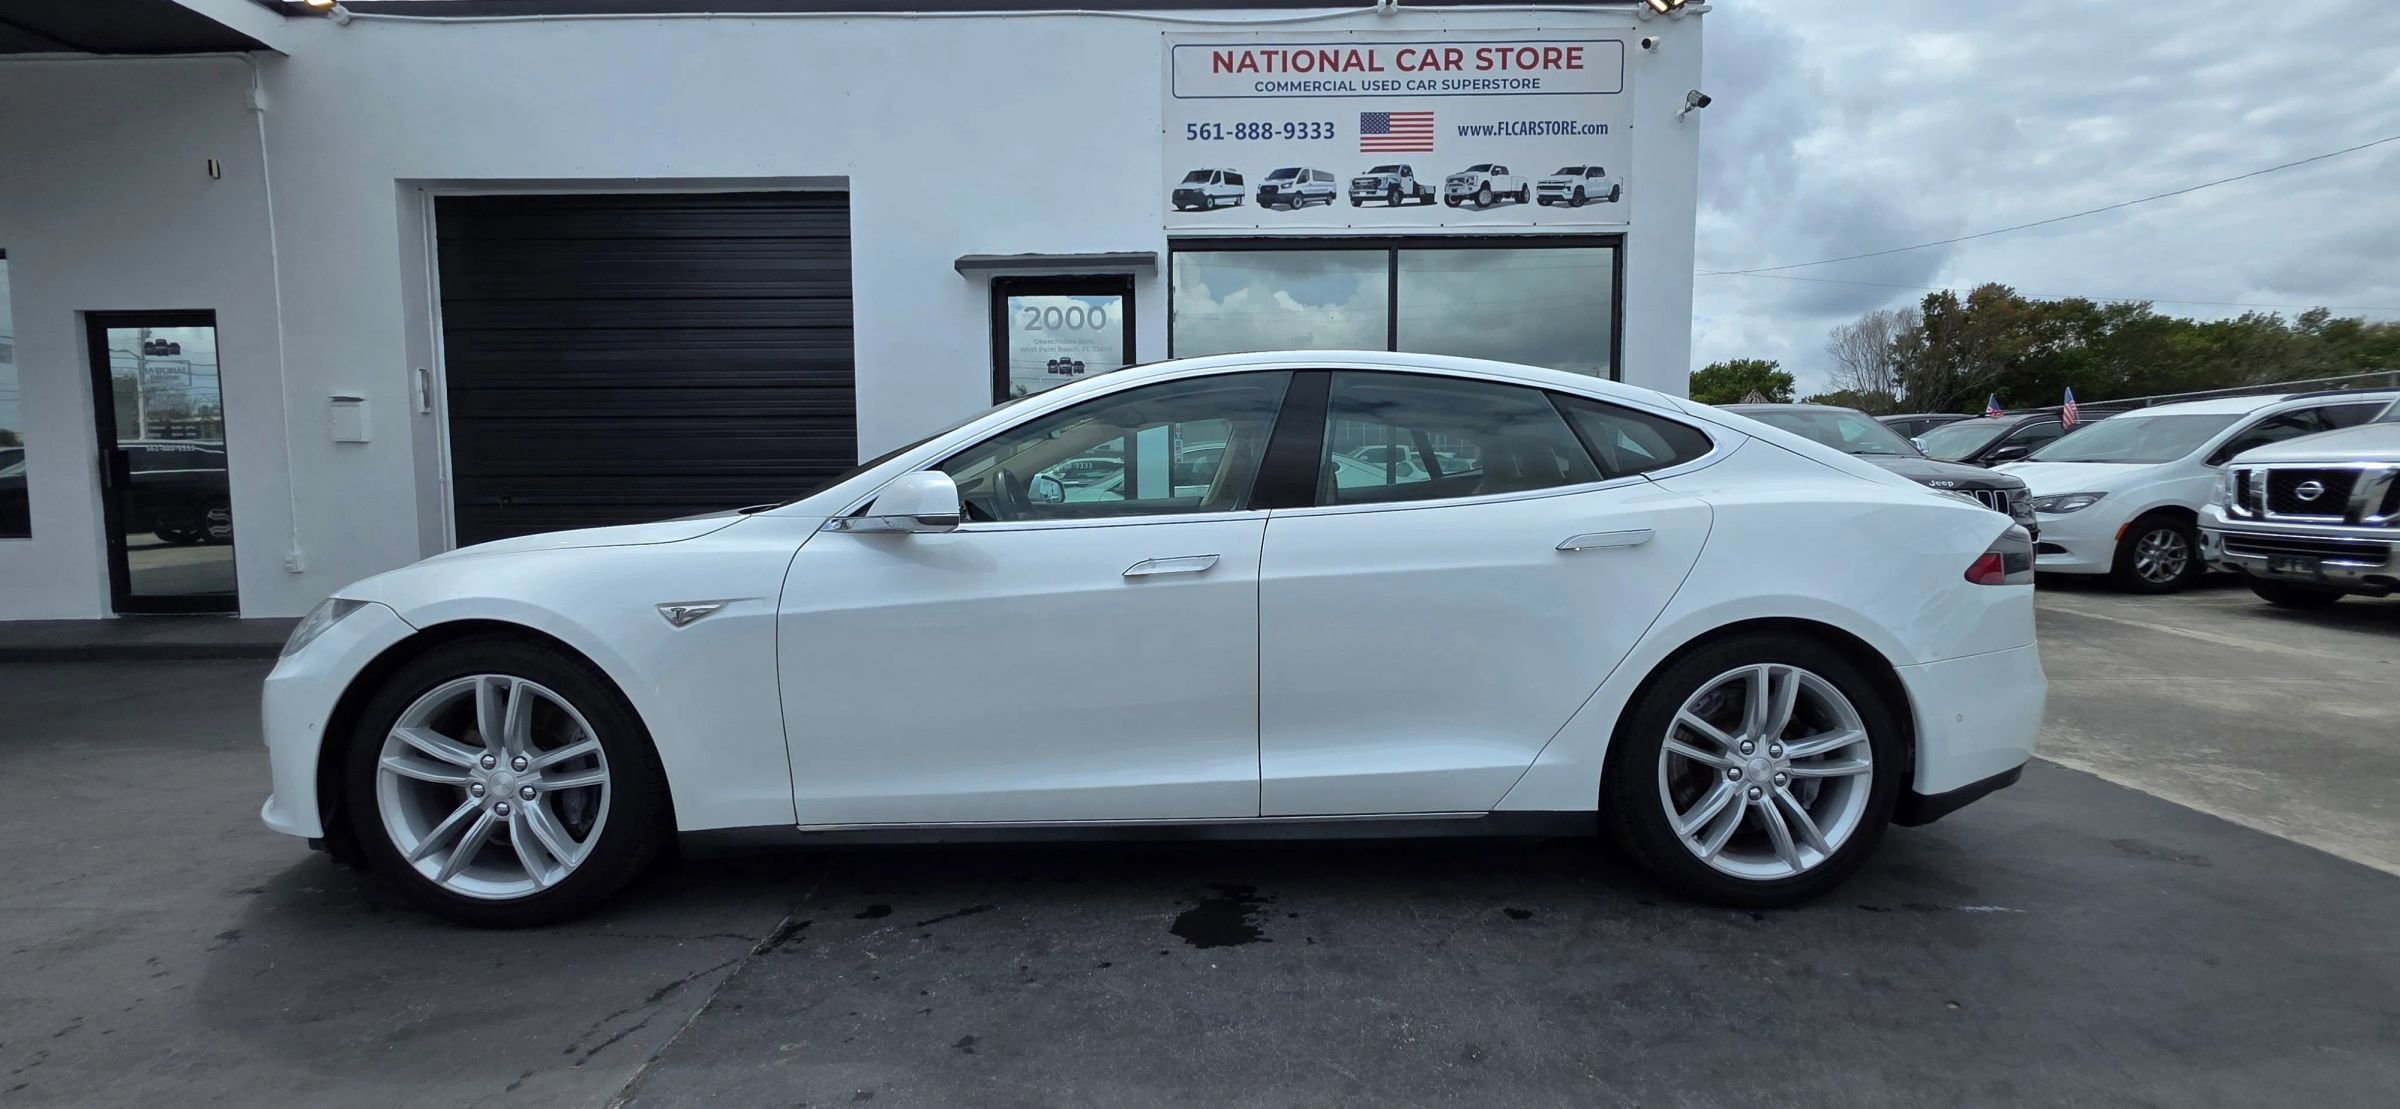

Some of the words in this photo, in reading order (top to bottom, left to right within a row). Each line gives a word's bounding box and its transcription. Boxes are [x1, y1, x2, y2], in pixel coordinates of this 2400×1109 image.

[1212, 49, 1385, 73] NATIONAL
[1395, 48, 1464, 72] CAR
[1475, 46, 1584, 71] STORE
[1254, 80, 1357, 93] COMMERCIAL
[1361, 79, 1401, 91] USED
[1406, 79, 1438, 91] CAR
[1441, 77, 1541, 90] SUPERSTORE
[1186, 121, 1336, 141] 561-888-9333
[1457, 120, 1609, 137] www.FLCARSTORE.com
[1023, 305, 1107, 331] 2000
